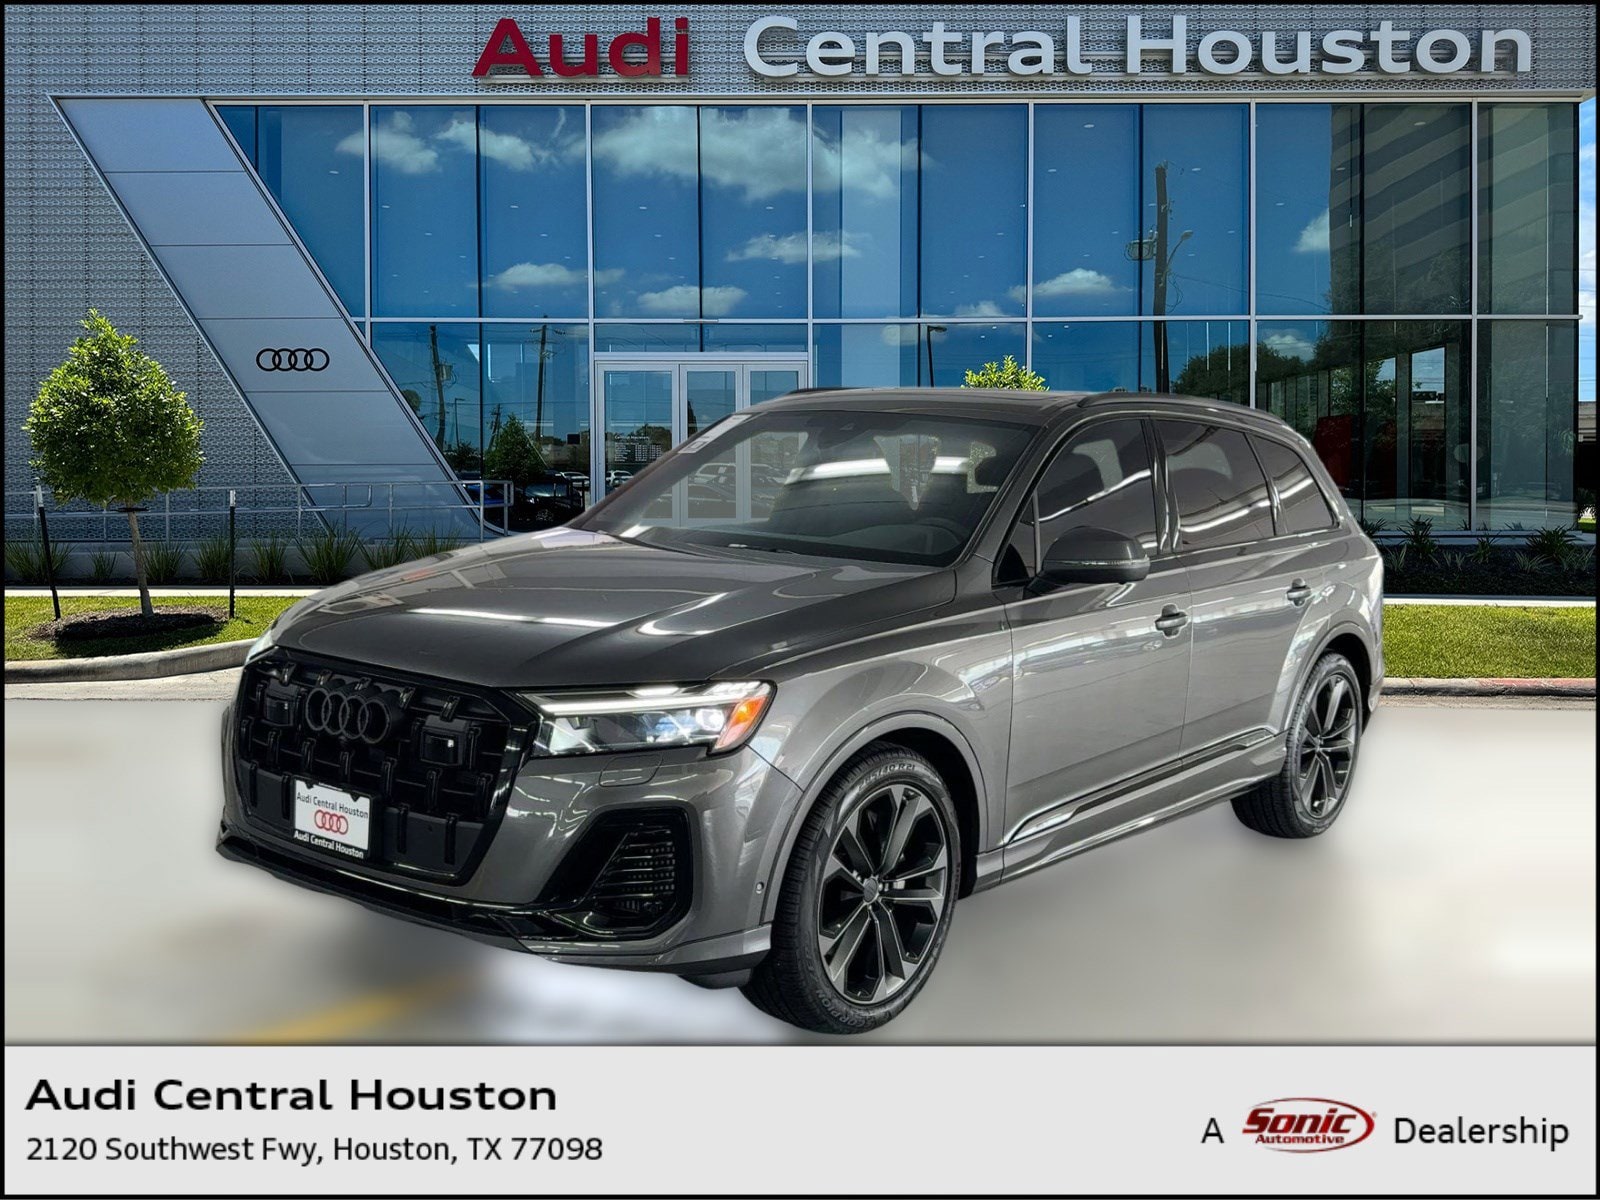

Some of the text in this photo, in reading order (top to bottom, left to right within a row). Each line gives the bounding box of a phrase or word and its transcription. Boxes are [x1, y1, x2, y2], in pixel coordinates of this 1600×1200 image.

[472, 15, 1531, 78] Audi Central Houston
[296, 792, 369, 819] Audi Central Houston
[293, 830, 364, 859] Audi Central Houston
